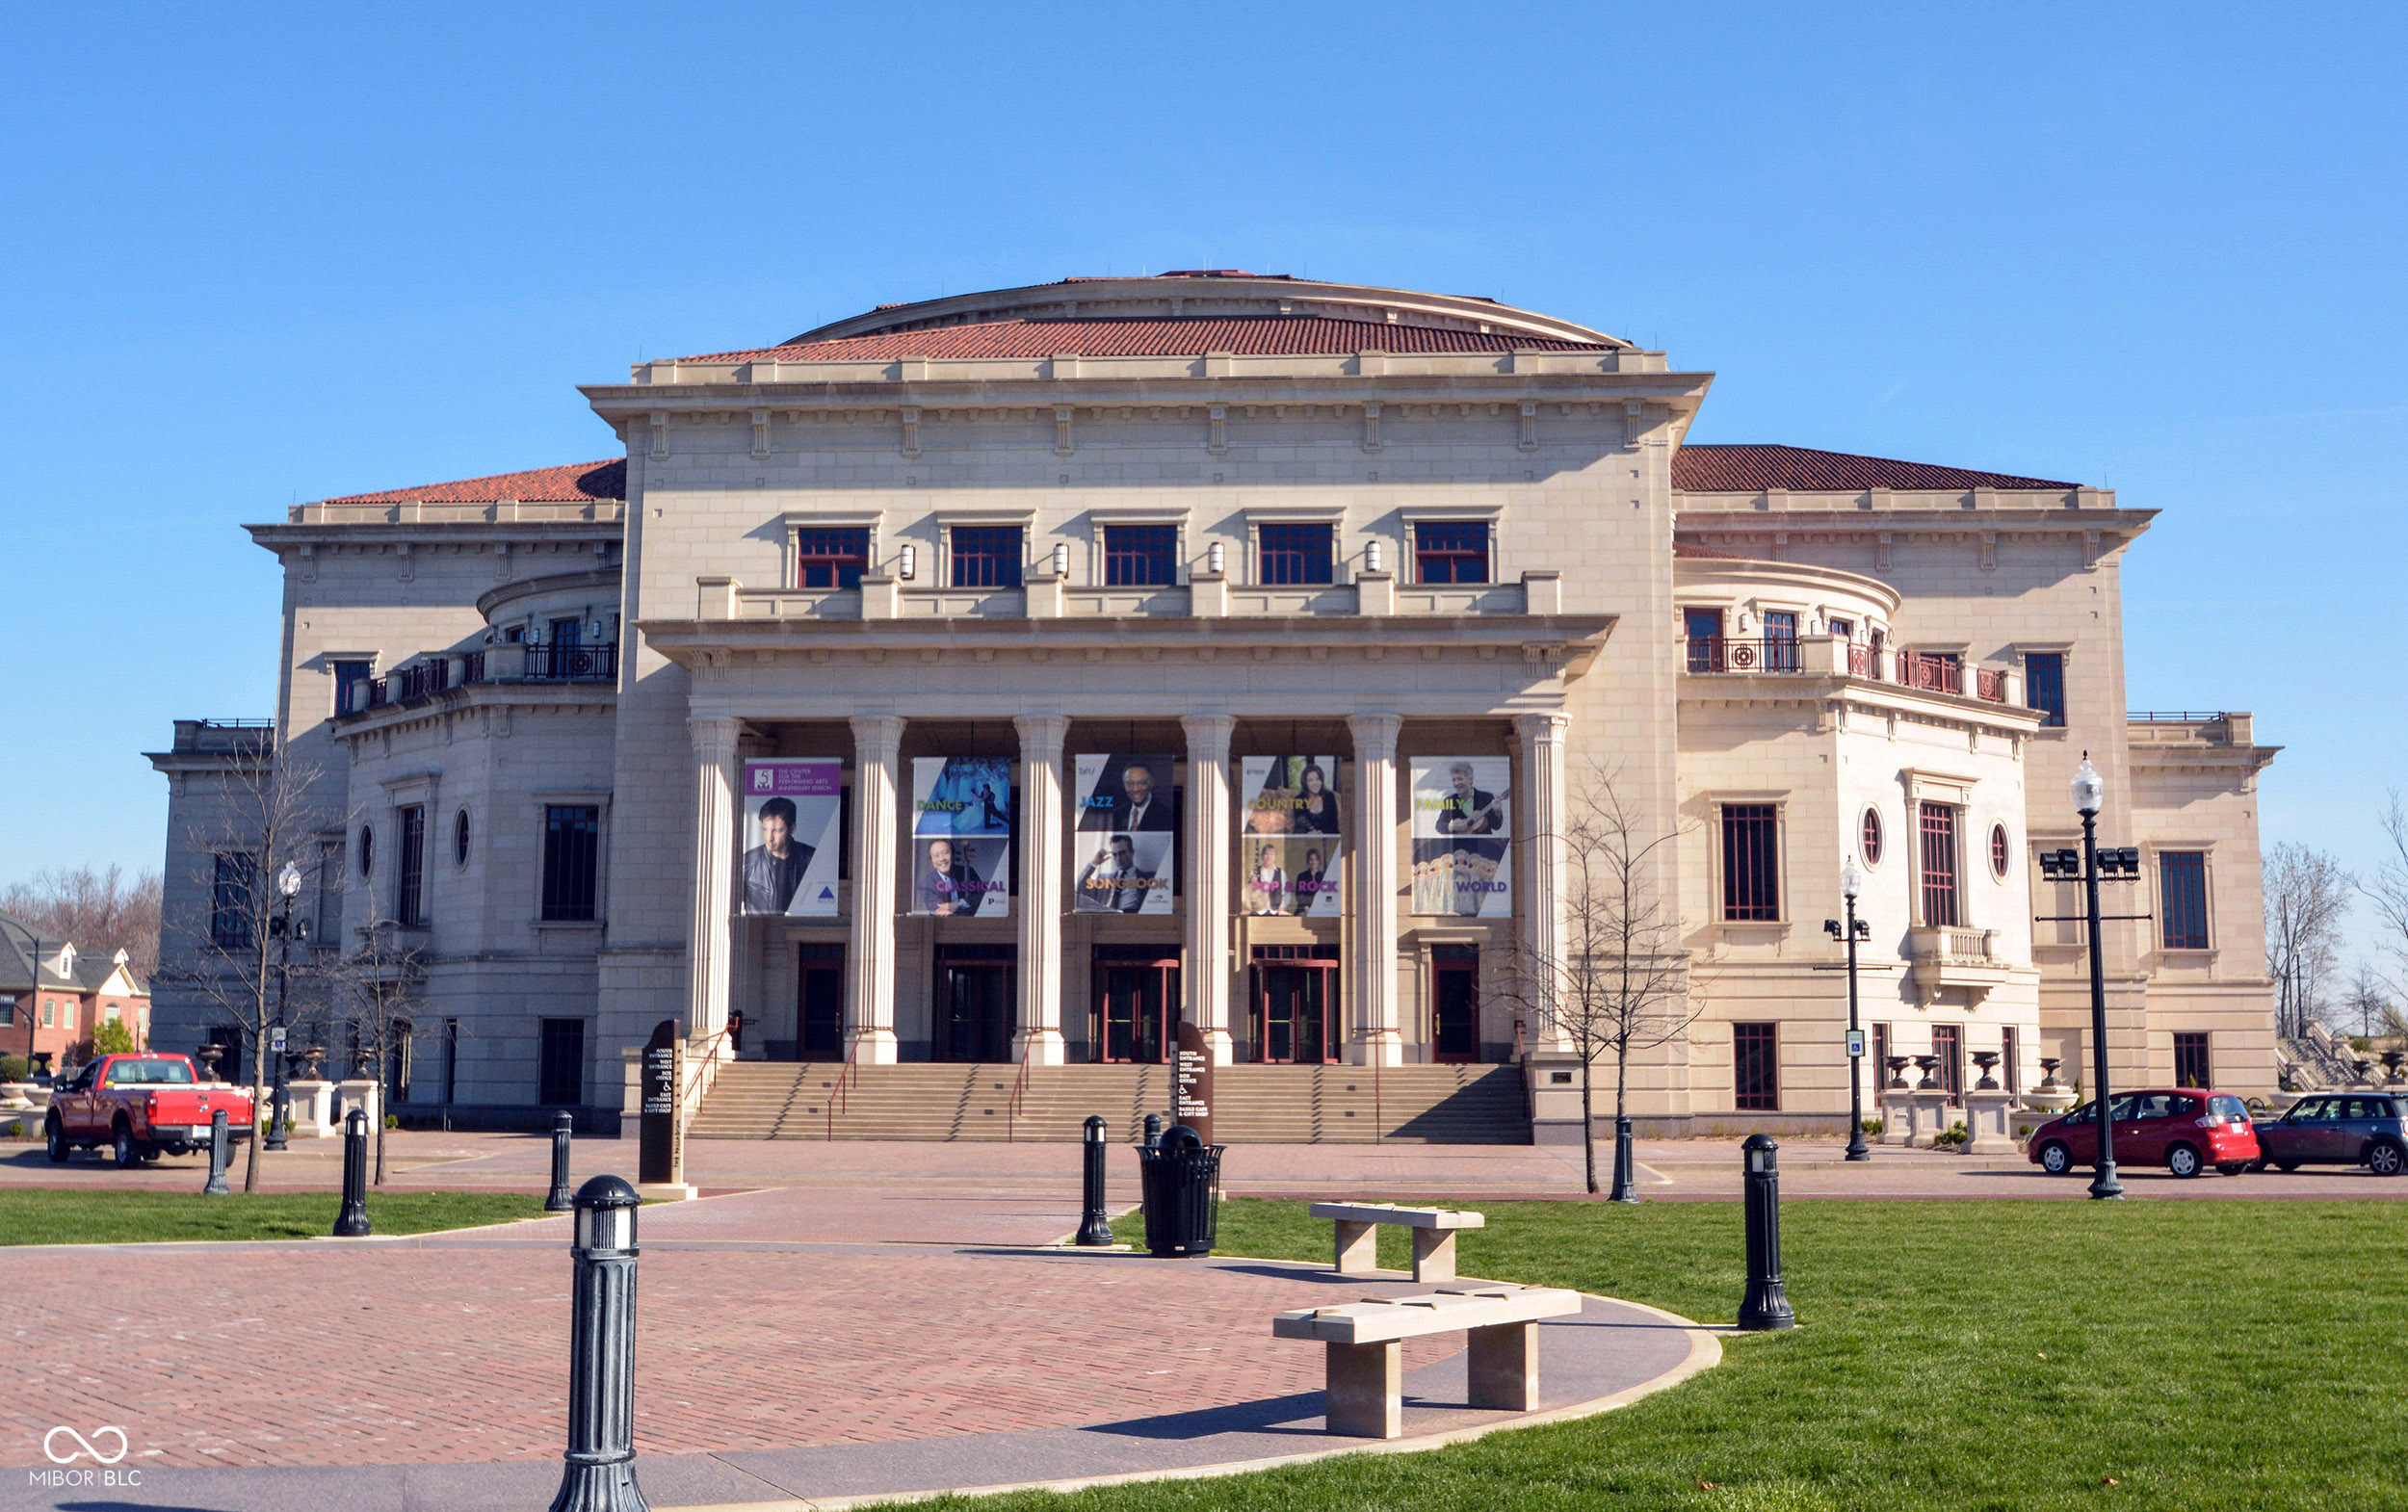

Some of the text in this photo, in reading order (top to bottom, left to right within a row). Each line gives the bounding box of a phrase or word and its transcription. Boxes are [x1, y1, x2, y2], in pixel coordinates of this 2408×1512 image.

[917, 800, 963, 811] DANCE
[1079, 795, 1114, 808] JAZZ
[1247, 798, 1312, 810] COUNTRY
[1416, 798, 1465, 810] FAMILY
[936, 881, 1007, 892] CLASSICAL
[1086, 877, 1169, 890] SONGBOOK
[1252, 880, 1339, 892] POP & ROCK
[1456, 881, 1507, 893] WORLD
